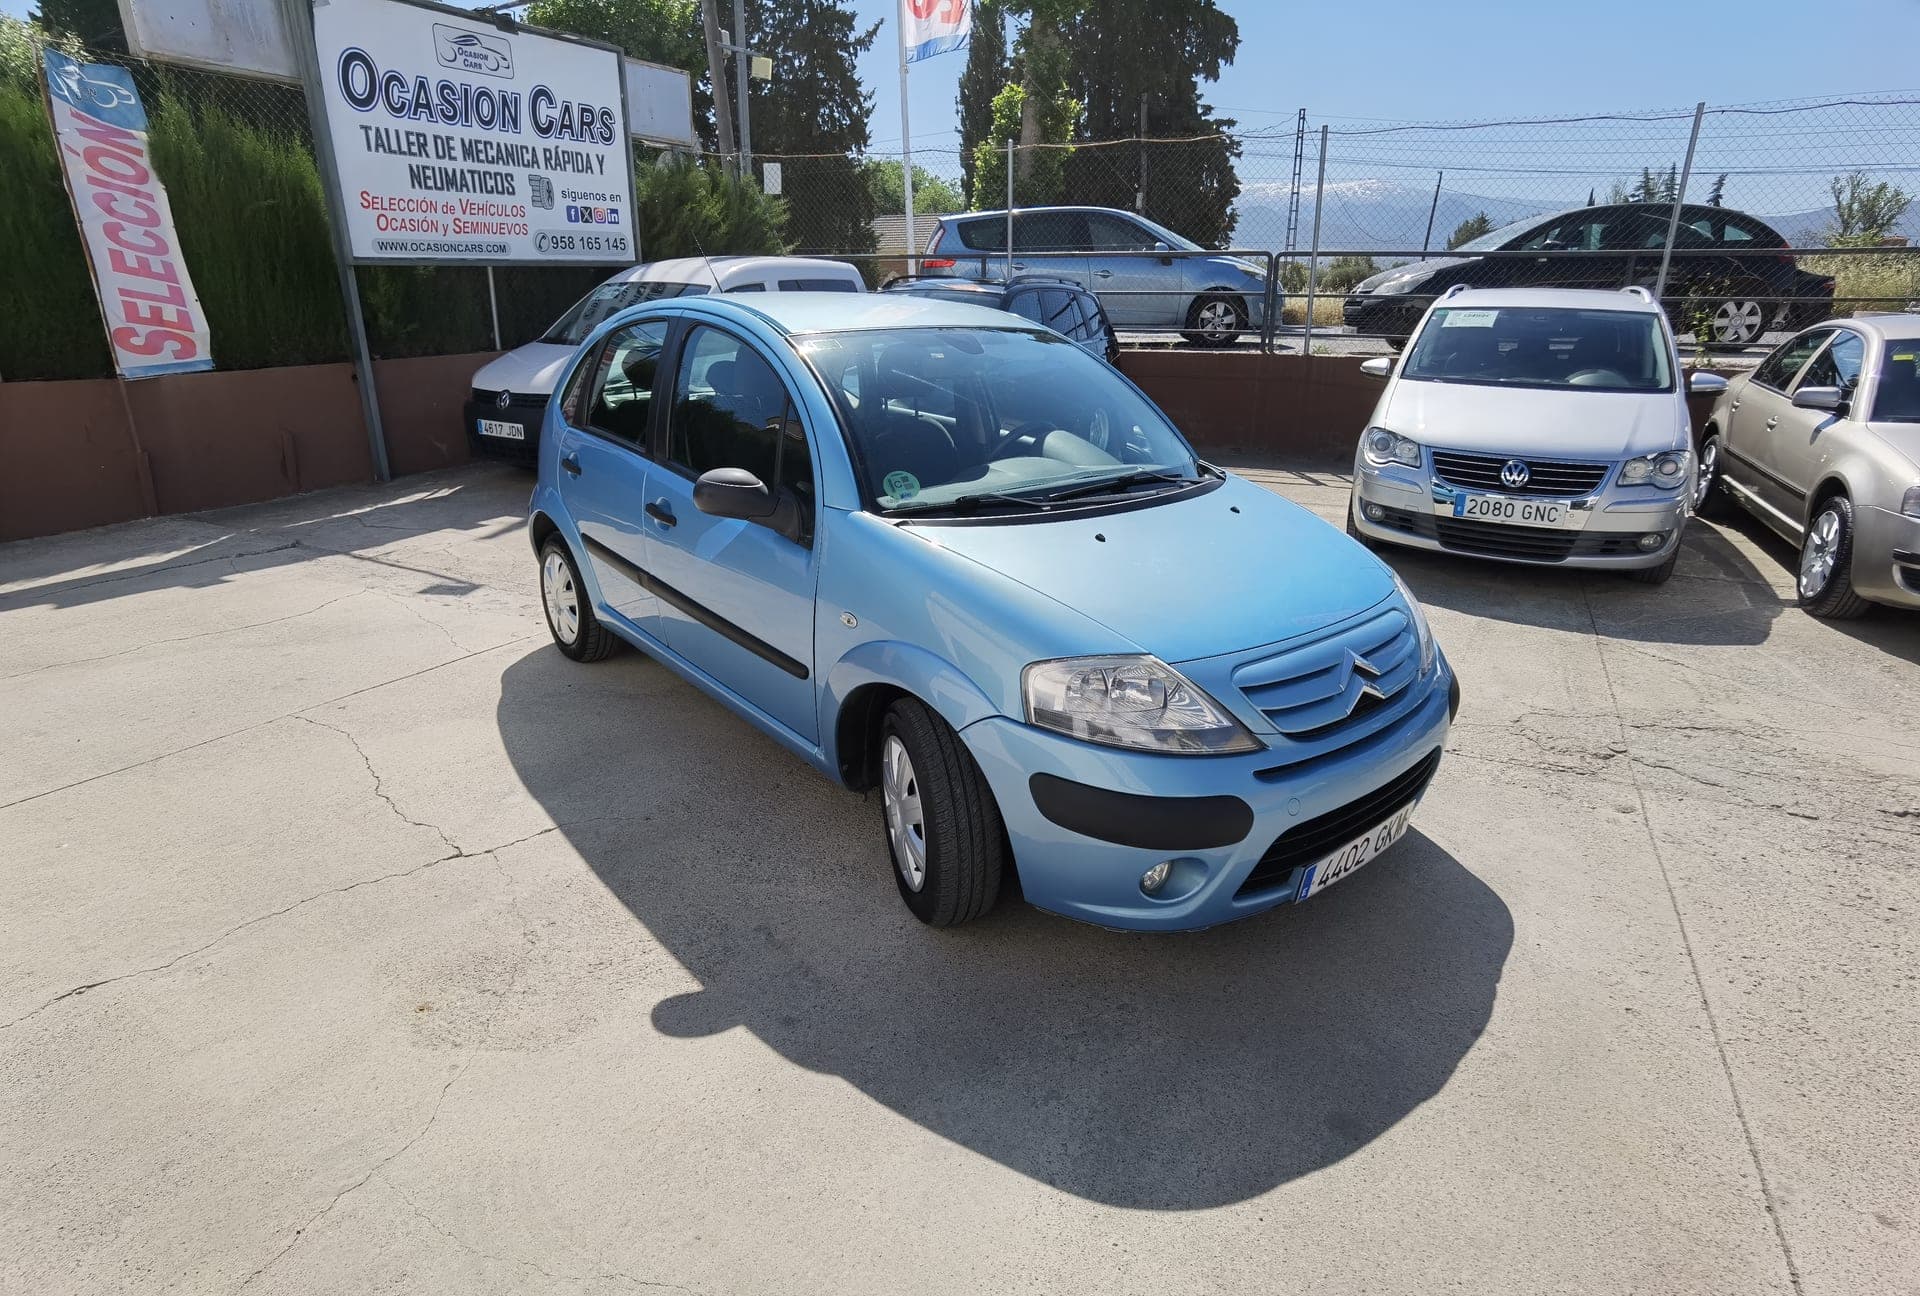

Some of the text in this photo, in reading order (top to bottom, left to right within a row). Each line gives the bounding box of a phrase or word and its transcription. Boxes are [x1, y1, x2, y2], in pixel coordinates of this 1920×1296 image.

[457, 47, 489, 61] OCASION
[463, 58, 483, 70] CARS
[337, 47, 616, 146] OCASION CARS
[359, 124, 606, 176] TALLER DE MECANICA RÁPIDA Y
[408, 164, 516, 197] NEUMATICOS
[360, 190, 526, 218] SELECCIÓN de VEHÍCULOS
[609, 194, 622, 202] en
[64, 107, 197, 360] SELECCIÓN
[376, 213, 528, 237] OCASIÓN y SEMINUEVOS
[377, 241, 507, 253] WWW.OCASIONCARS.COM
[551, 236, 626, 251] 958 165 145
[506, 426, 523, 438] JDN
[1467, 499, 1559, 523] 2080 GNC
[1317, 837, 1370, 887] 4402
